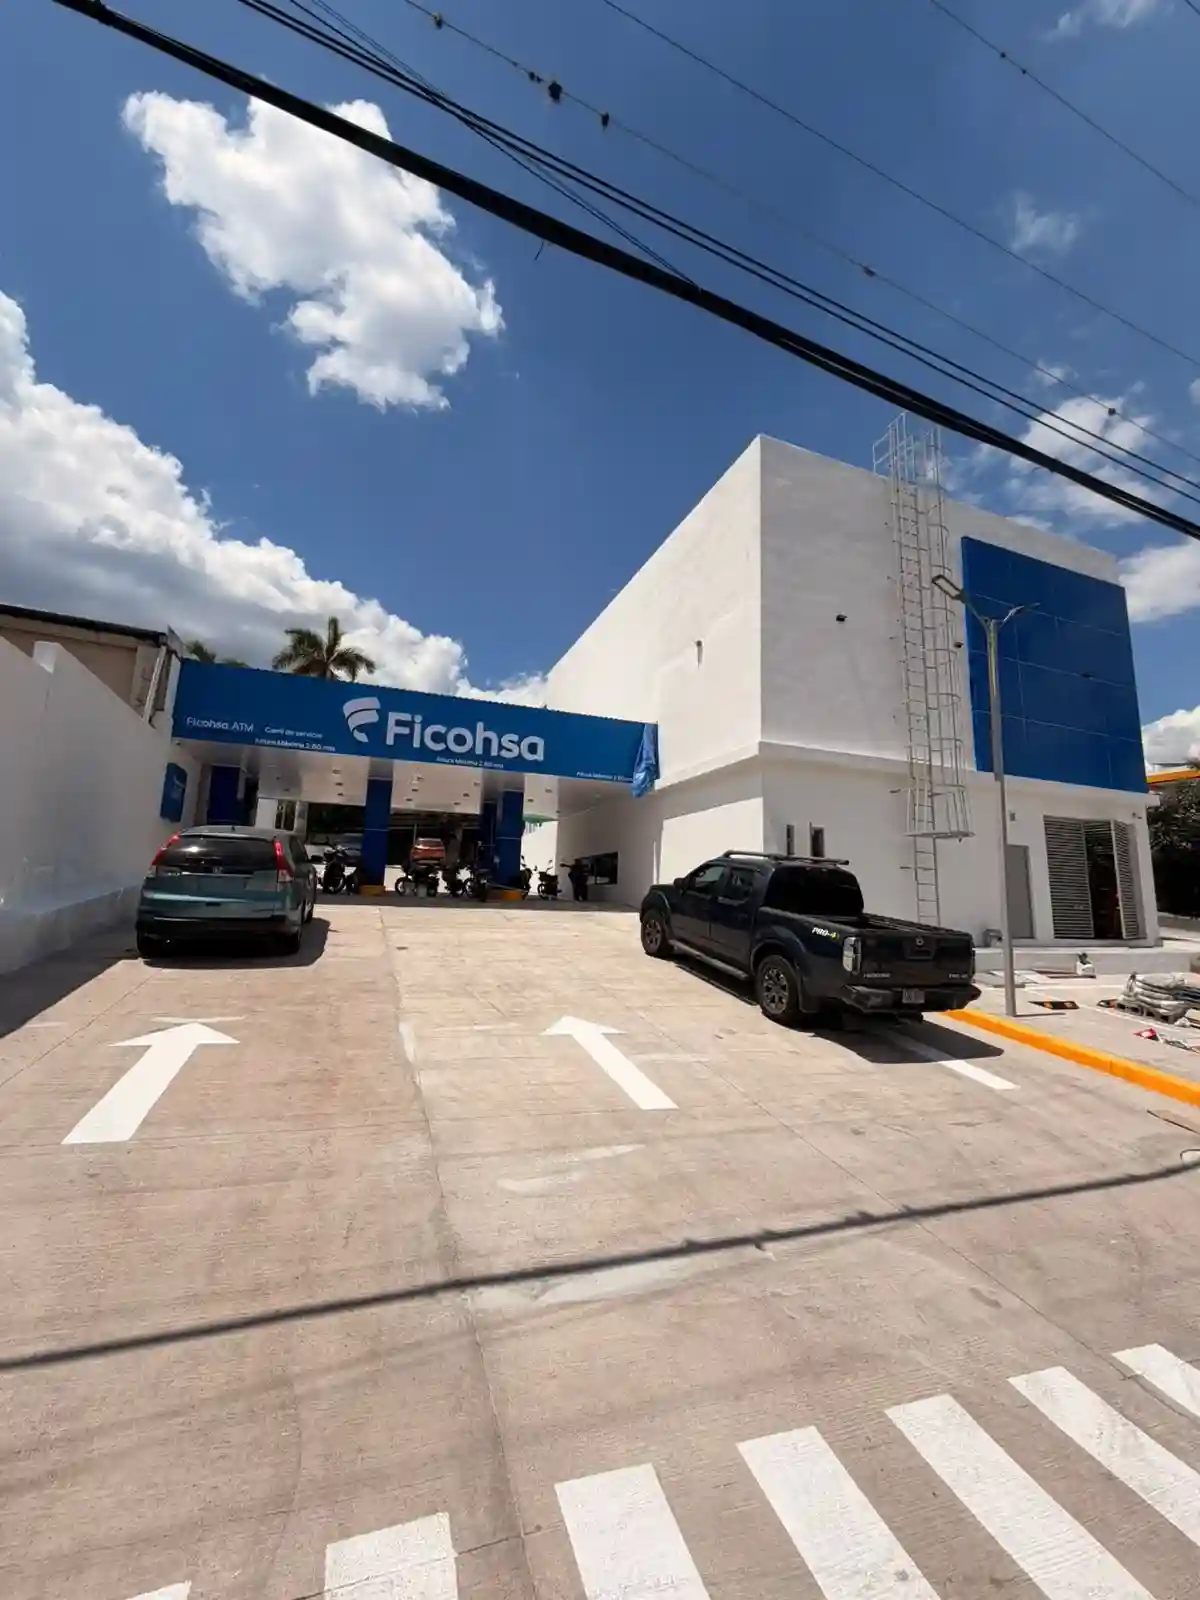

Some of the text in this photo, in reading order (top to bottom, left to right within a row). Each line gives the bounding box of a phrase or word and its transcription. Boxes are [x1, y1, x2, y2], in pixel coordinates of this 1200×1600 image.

[186, 716, 254, 732] Ficohsa ATM
[386, 711, 545, 762] Ficohsa
